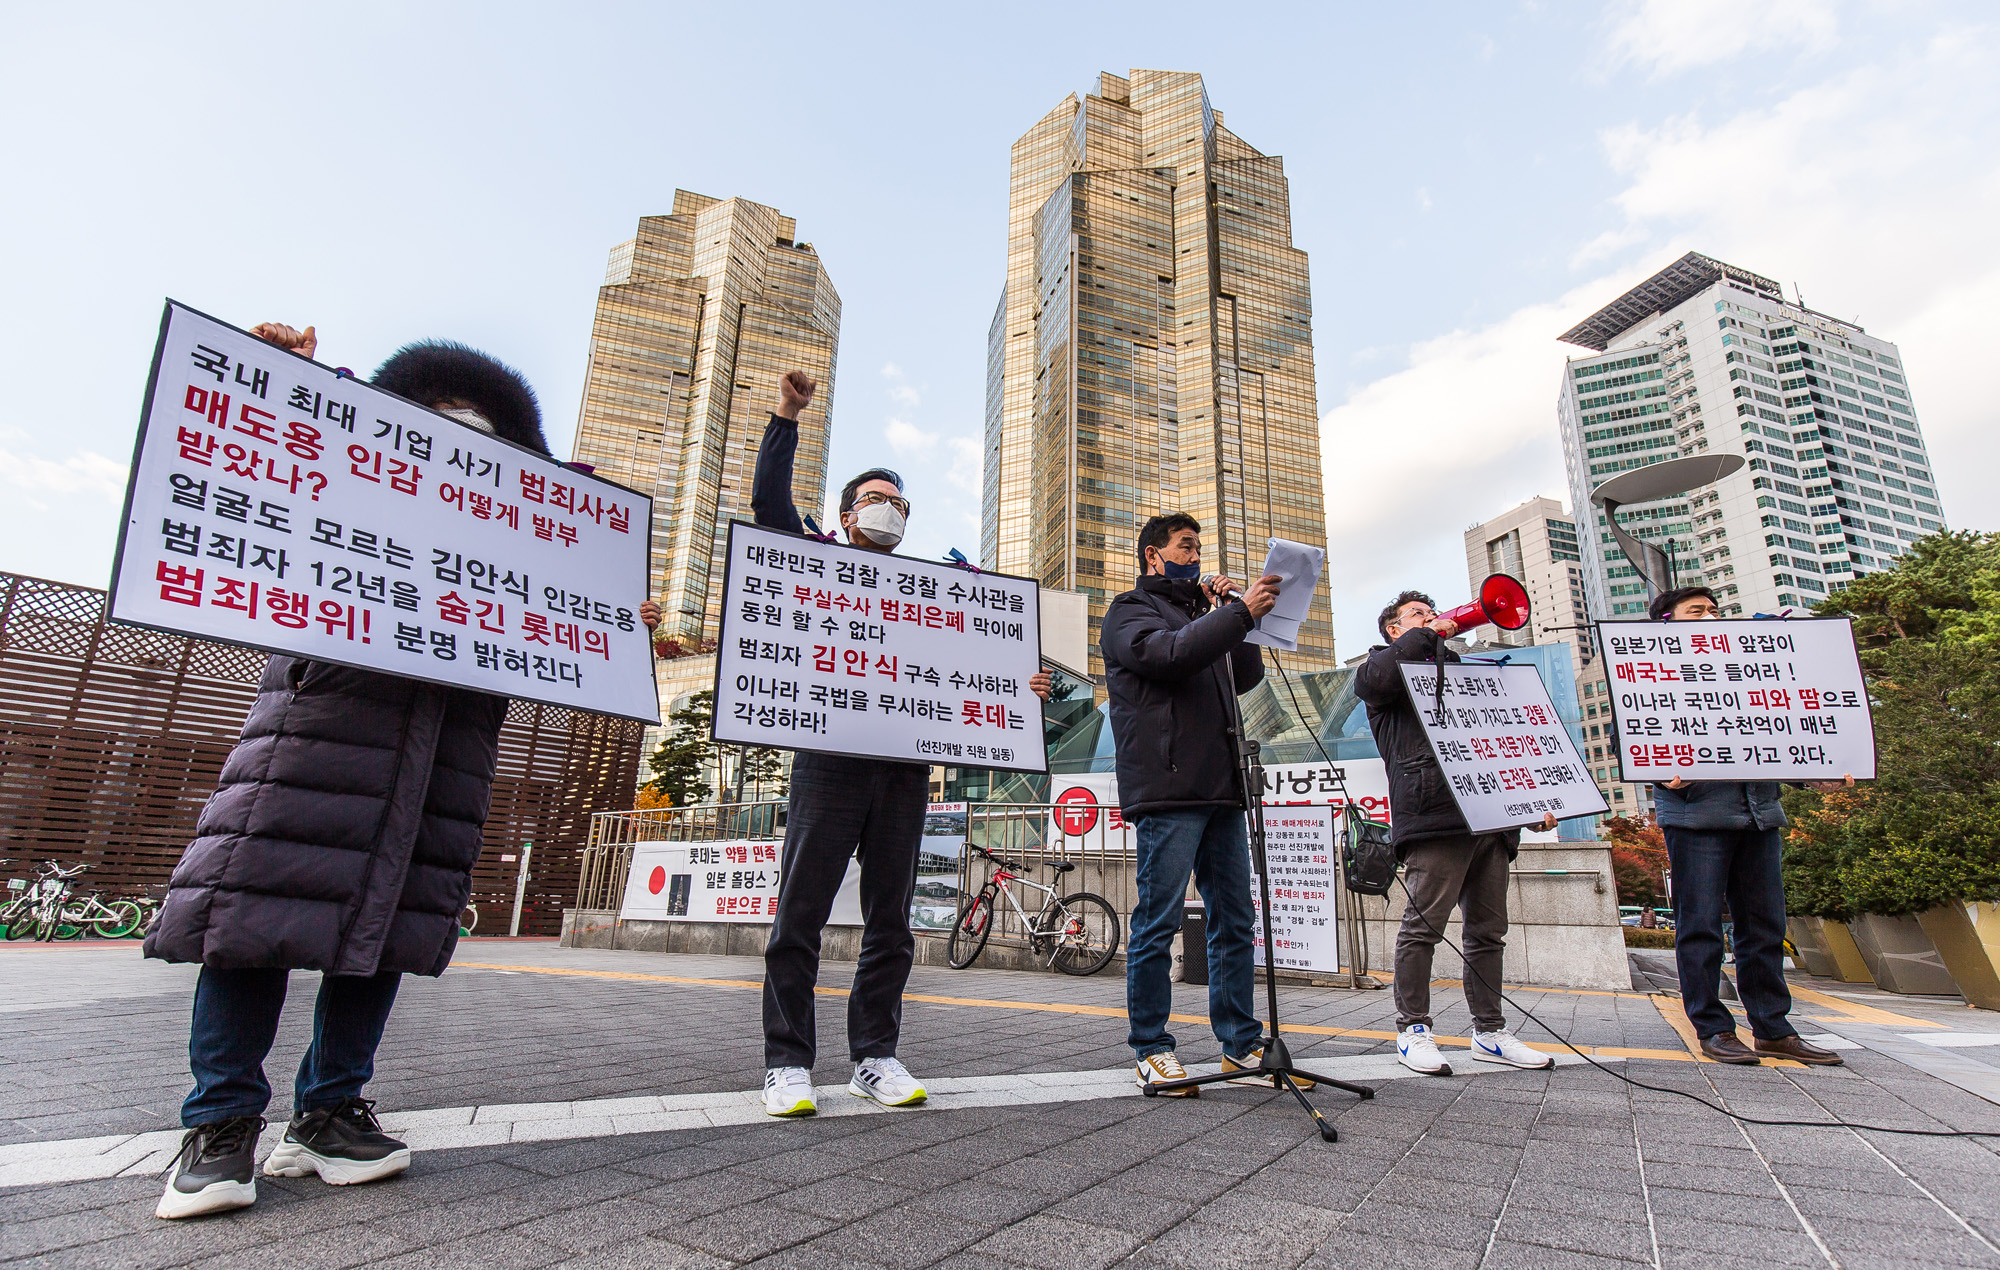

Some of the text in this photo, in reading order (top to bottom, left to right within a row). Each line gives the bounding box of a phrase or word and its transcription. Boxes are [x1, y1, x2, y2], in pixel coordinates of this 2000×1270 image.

[191, 344, 630, 534] 국내 최대 기업 사기 범죄사실
[177, 426, 328, 502] 받았나?
[184, 385, 579, 547] 매도용 인감 어떻게 발부
[168, 473, 636, 632] 얼굴도 모르는 김안식 인감도용
[161, 519, 611, 660] 범죄자 12년을 숨긴 롯데의
[747, 546, 826, 577] 대한민국
[947, 582, 1025, 613] 수사관을
[742, 576, 1023, 641] 모두 부실수사 범죄은폐 막이에
[155, 560, 583, 688] 범죄행위! 분명 밝혀진다
[740, 601, 886, 644] 동원 할 수 없다
[1610, 634, 1795, 655] 일본기업 롯데 앞잡이
[738, 637, 801, 666] 범죄자
[904, 664, 940, 687] 구속
[949, 671, 1018, 697] 수사하라
[1616, 662, 1717, 683] 매국노들은
[1455, 677, 1487, 696] 노른자
[736, 674, 1024, 730] 이나라 국법을 무시하는 롯데는
[1622, 688, 1861, 711] 이나라 국민이 피와 땀으로
[733, 703, 827, 734] 각성하라!
[1457, 708, 1482, 729] 많이
[1480, 708, 1512, 727] 가지고
[1512, 708, 1525, 725] 또
[1626, 715, 1837, 736] 모은 재산 수천억이 매년
[916, 738, 1014, 762] (선진개발 직원 일동)
[1437, 740, 1472, 763] 롯데는
[1470, 737, 1497, 760] 위조
[1629, 744, 1833, 767] 일본땅으로 가고 있다.
[1452, 774, 1479, 796] 뒤에
[1478, 772, 1501, 794] 숨어
[1499, 767, 1537, 790] 도적질
[1504, 797, 1565, 817] (선진개발 직원 일동)
[690, 845, 776, 864] 롯데는 약탈 민족
[1289, 843, 1324, 851] 선진개발에
[707, 872, 726, 889] 일본
[732, 871, 766, 889] 홀딩스
[1296, 880, 1329, 888] 구속되는데
[716, 897, 761, 914] 일본으로
[1275, 889, 1299, 899] 롯데의
[1303, 891, 1325, 900] 범죄자
